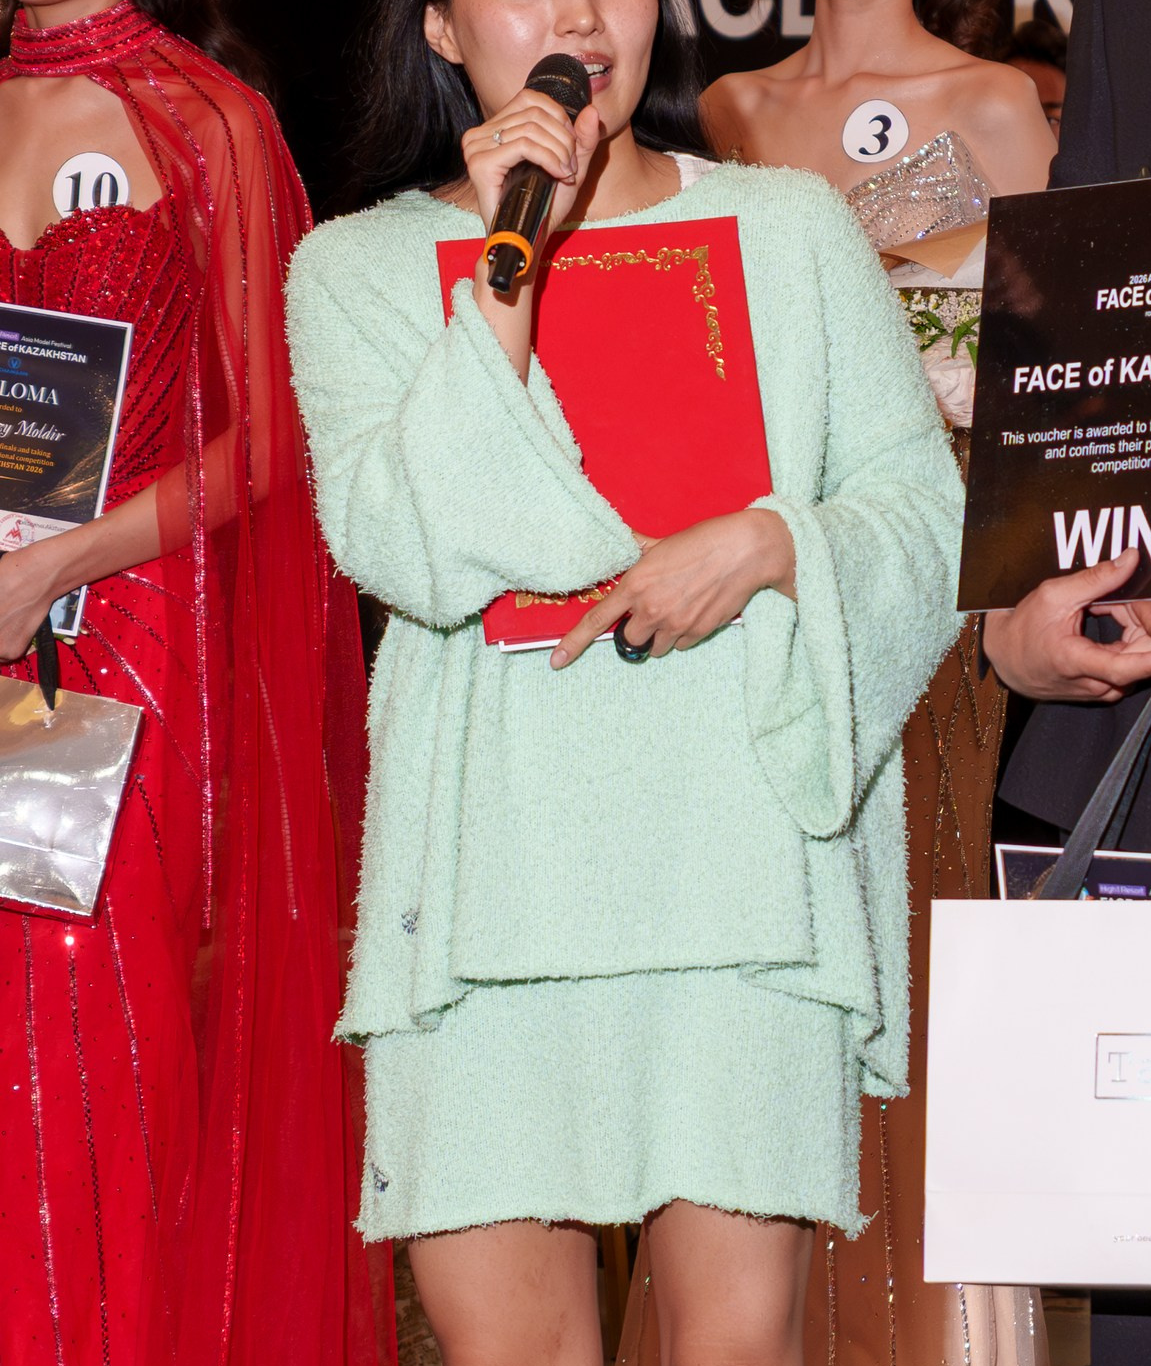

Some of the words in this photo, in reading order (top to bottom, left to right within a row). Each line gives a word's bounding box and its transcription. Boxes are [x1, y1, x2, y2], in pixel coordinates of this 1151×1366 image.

[858, 114, 892, 156] 3
[63, 170, 119, 213] 10
[1129, 273, 1147, 285] 2026
[1096, 285, 1145, 310] FACE
[8, 344, 19, 353] of
[18, 345, 88, 364] KAZAKHSTAN
[1013, 362, 1082, 394] FACE
[1088, 358, 1115, 387] of
[14, 420, 65, 441] Moldir
[1002, 431, 1025, 446] This
[1027, 427, 1072, 443] voucher
[1073, 426, 1083, 439] is
[1086, 421, 1134, 438] awarded
[1135, 421, 1147, 434] to
[1045, 445, 1066, 460] and
[1068, 442, 1116, 458] confirms
[1118, 438, 1144, 453] their
[26, 465, 43, 474] 2026
